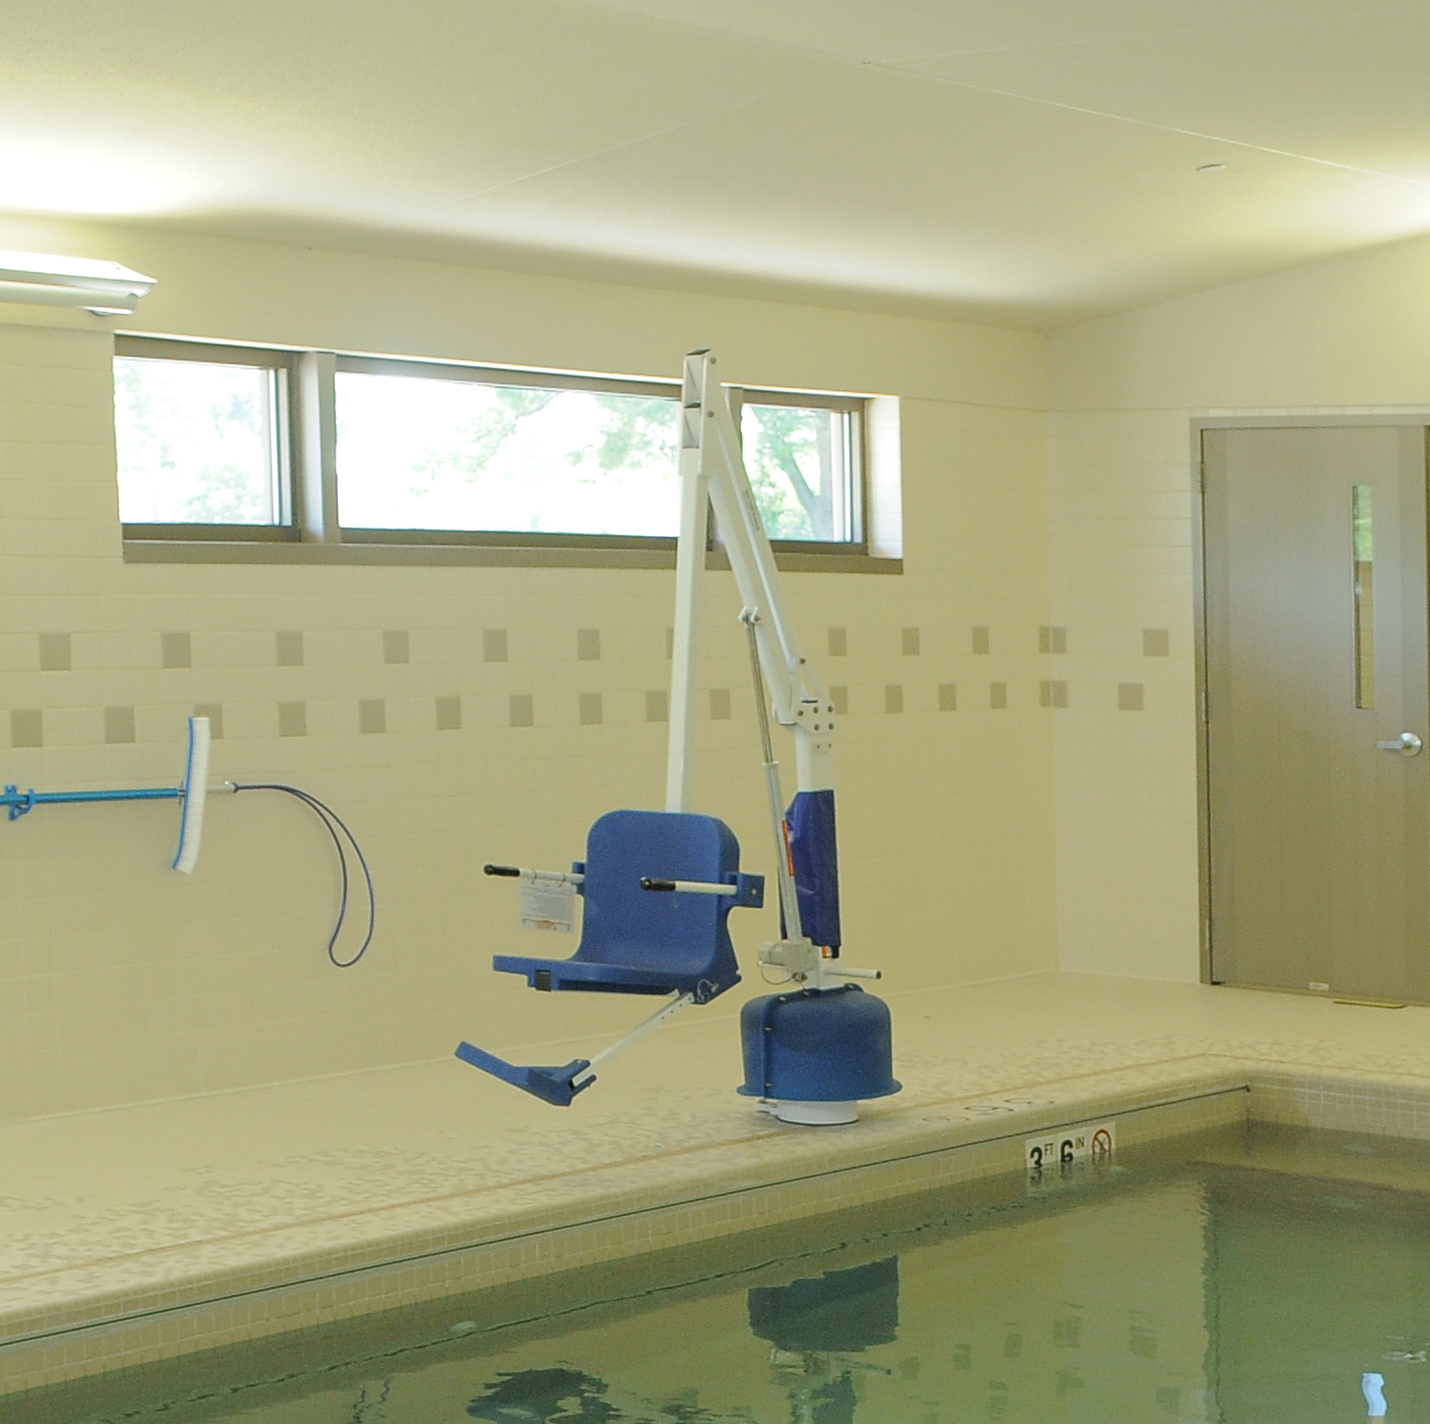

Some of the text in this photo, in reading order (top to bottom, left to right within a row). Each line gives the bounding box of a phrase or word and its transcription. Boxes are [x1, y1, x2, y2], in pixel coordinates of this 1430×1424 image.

[1044, 1142, 1054, 1156] FT
[1060, 1139, 1074, 1163] 6
[1075, 1136, 1085, 1149] IN
